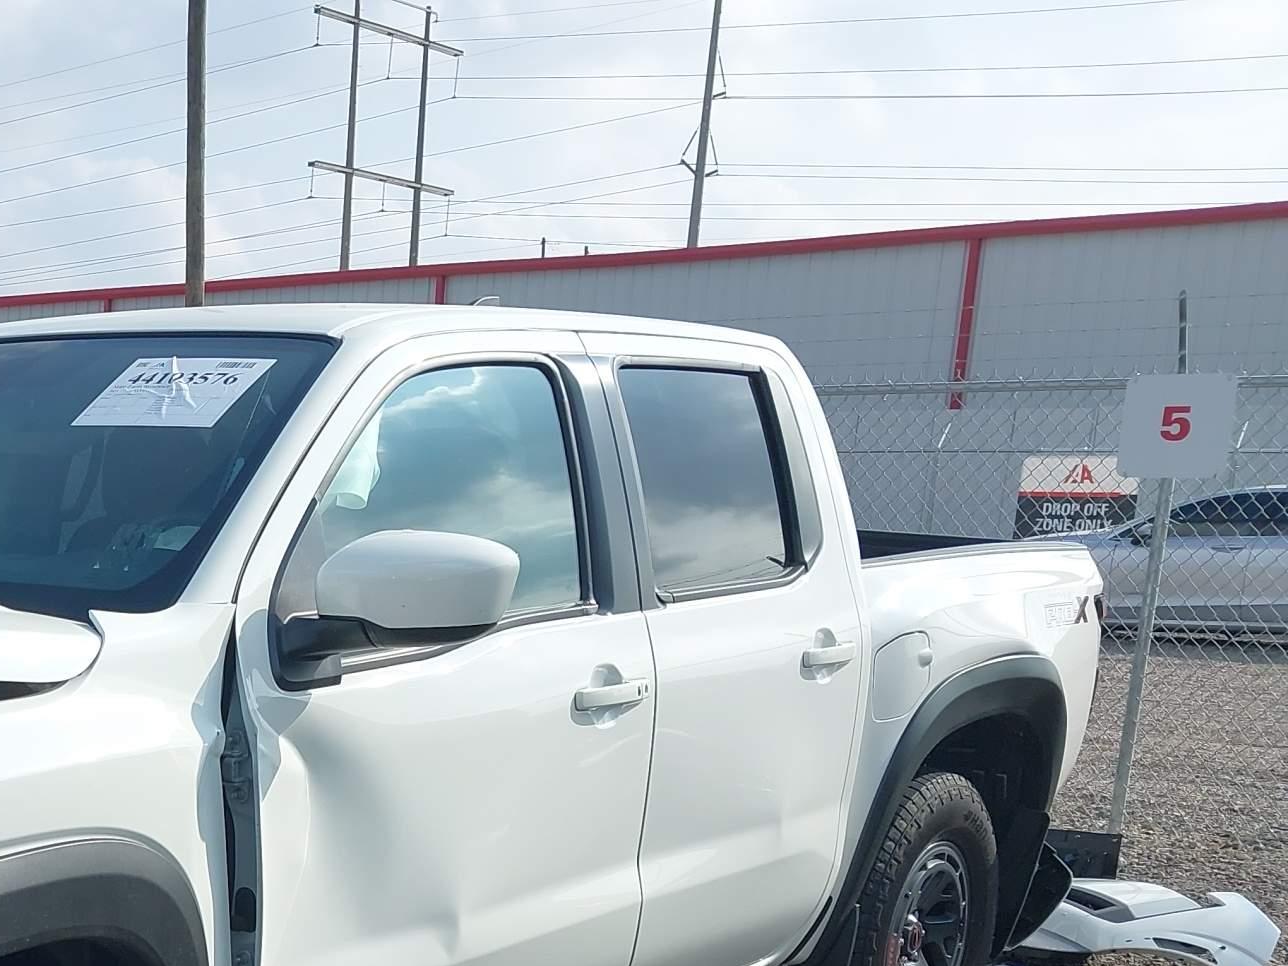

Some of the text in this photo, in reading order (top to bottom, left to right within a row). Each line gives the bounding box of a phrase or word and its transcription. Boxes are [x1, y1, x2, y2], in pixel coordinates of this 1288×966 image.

[127, 372, 243, 385] 44103576
[1159, 405, 1192, 441] 5
[1042, 502, 1110, 516] DROP OFF
[1034, 518, 1112, 532] ZONE ONLY
